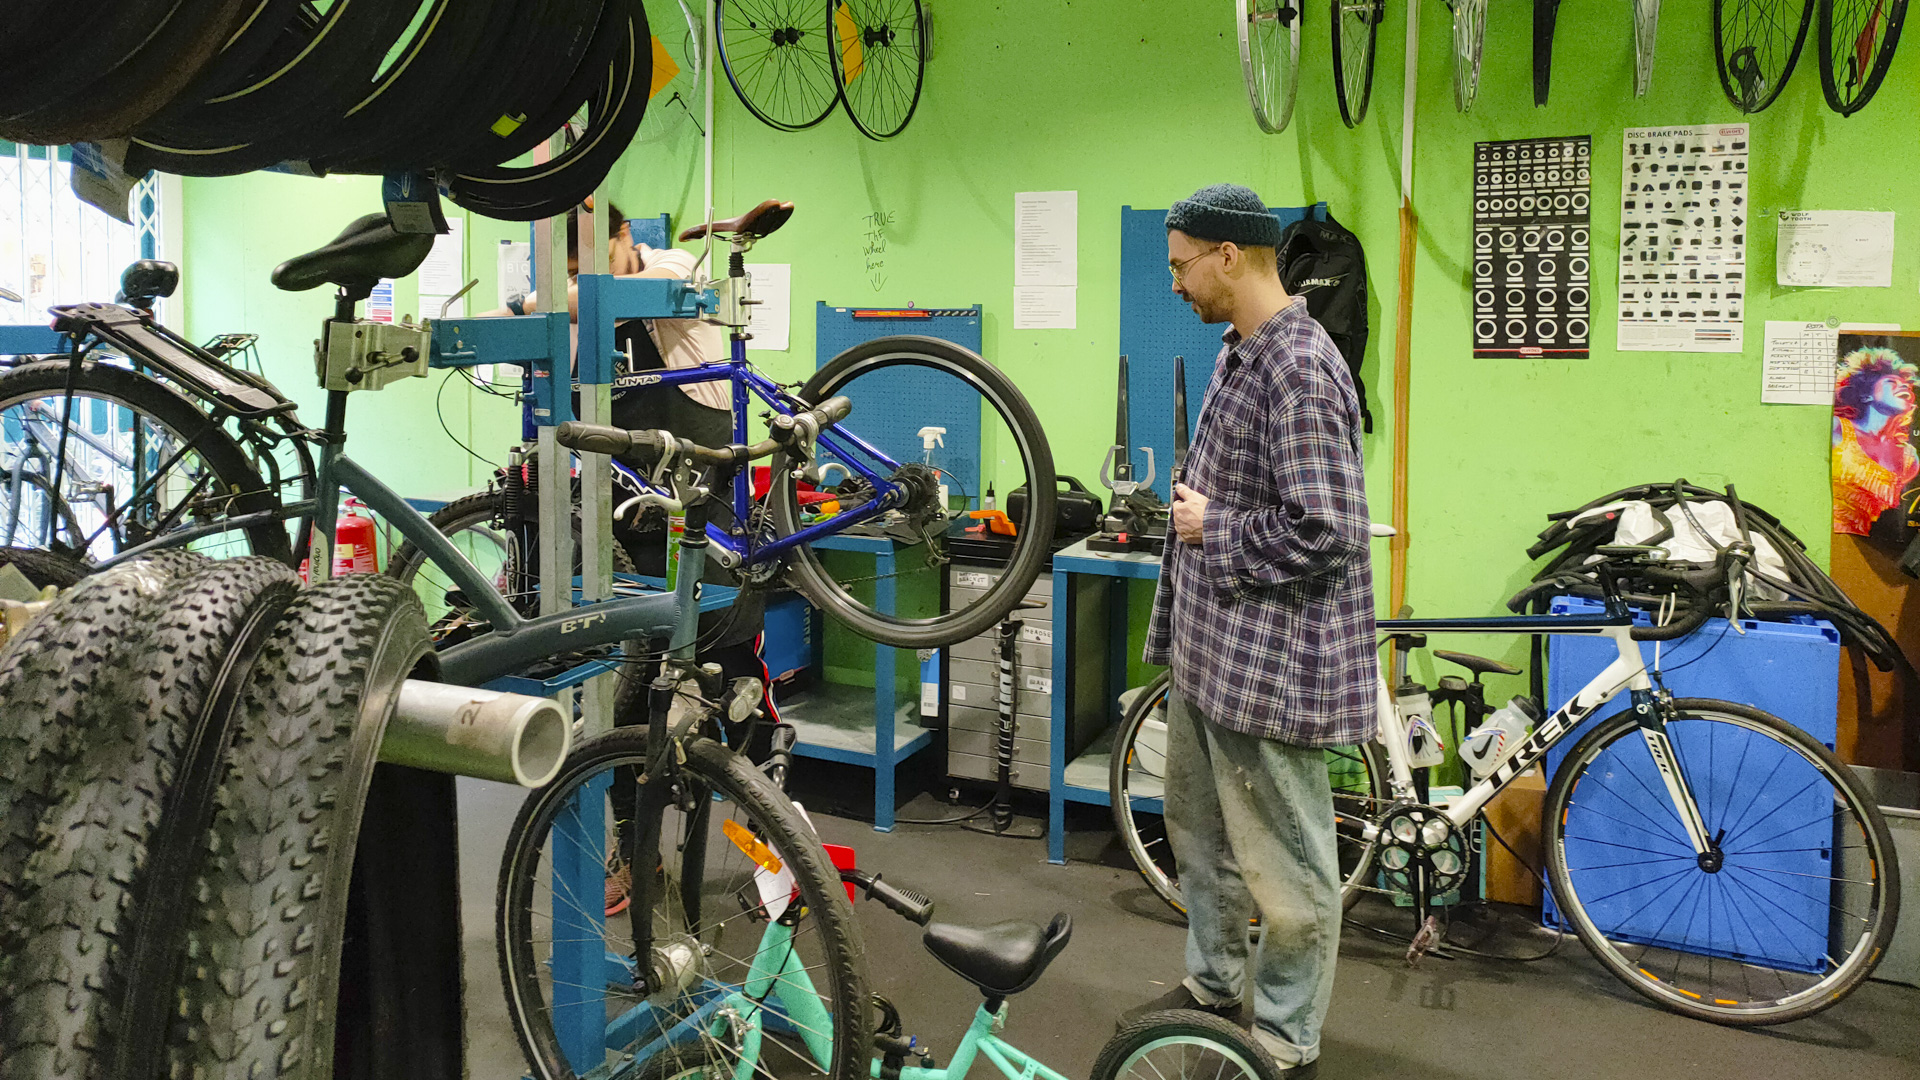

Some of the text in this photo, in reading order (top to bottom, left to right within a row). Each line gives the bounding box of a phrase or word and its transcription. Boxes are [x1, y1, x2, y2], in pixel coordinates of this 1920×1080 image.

[1627, 131, 1645, 139] DISC
[1673, 129, 1693, 137] PADS
[862, 210, 896, 228] TRUE
[611, 375, 662, 388] UNTAIN
[1024, 627, 1053, 638] HEADSE
[1489, 694, 1590, 789] TREK
